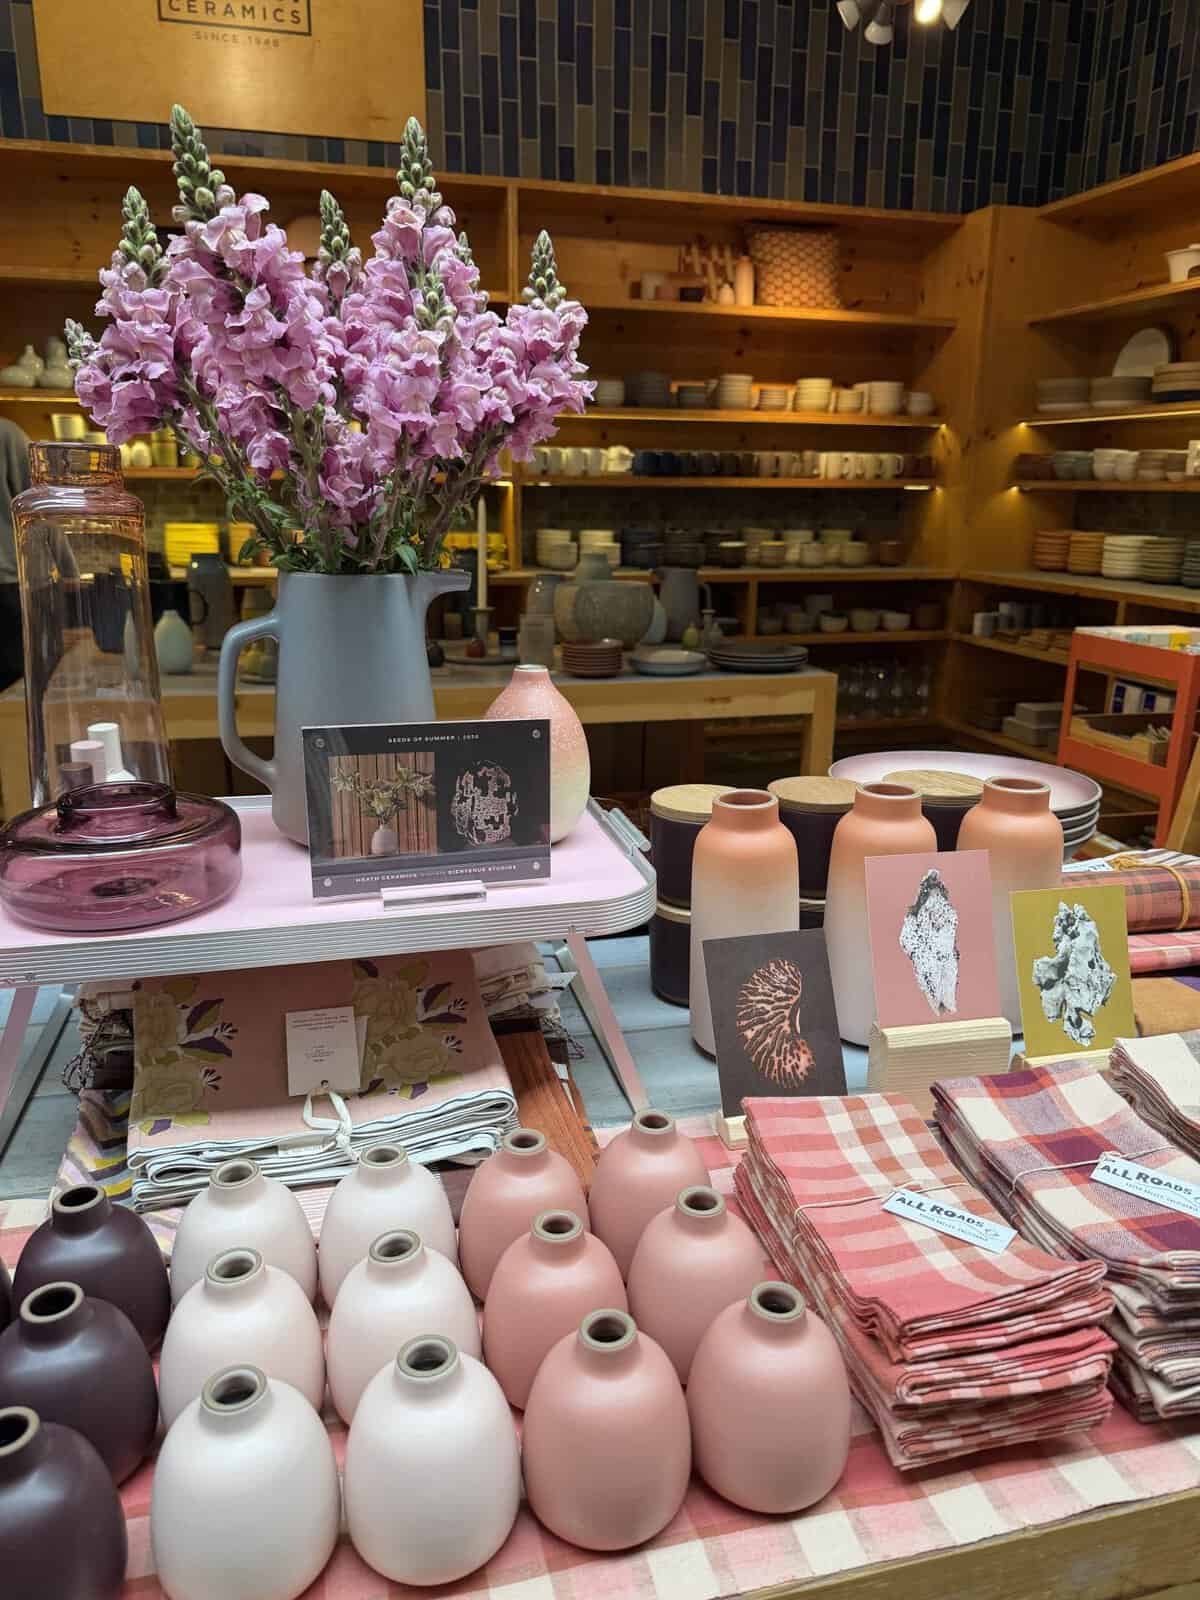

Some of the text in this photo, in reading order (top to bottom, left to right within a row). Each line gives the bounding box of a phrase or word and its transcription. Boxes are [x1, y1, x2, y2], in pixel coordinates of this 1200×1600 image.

[168, 0, 302, 25] CERAMICS
[192, 31, 239, 44] SINCE
[1101, 1165, 1193, 1195] ALL ROADS
[896, 1197, 926, 1211] ALL
[930, 1204, 985, 1227] ROADS
